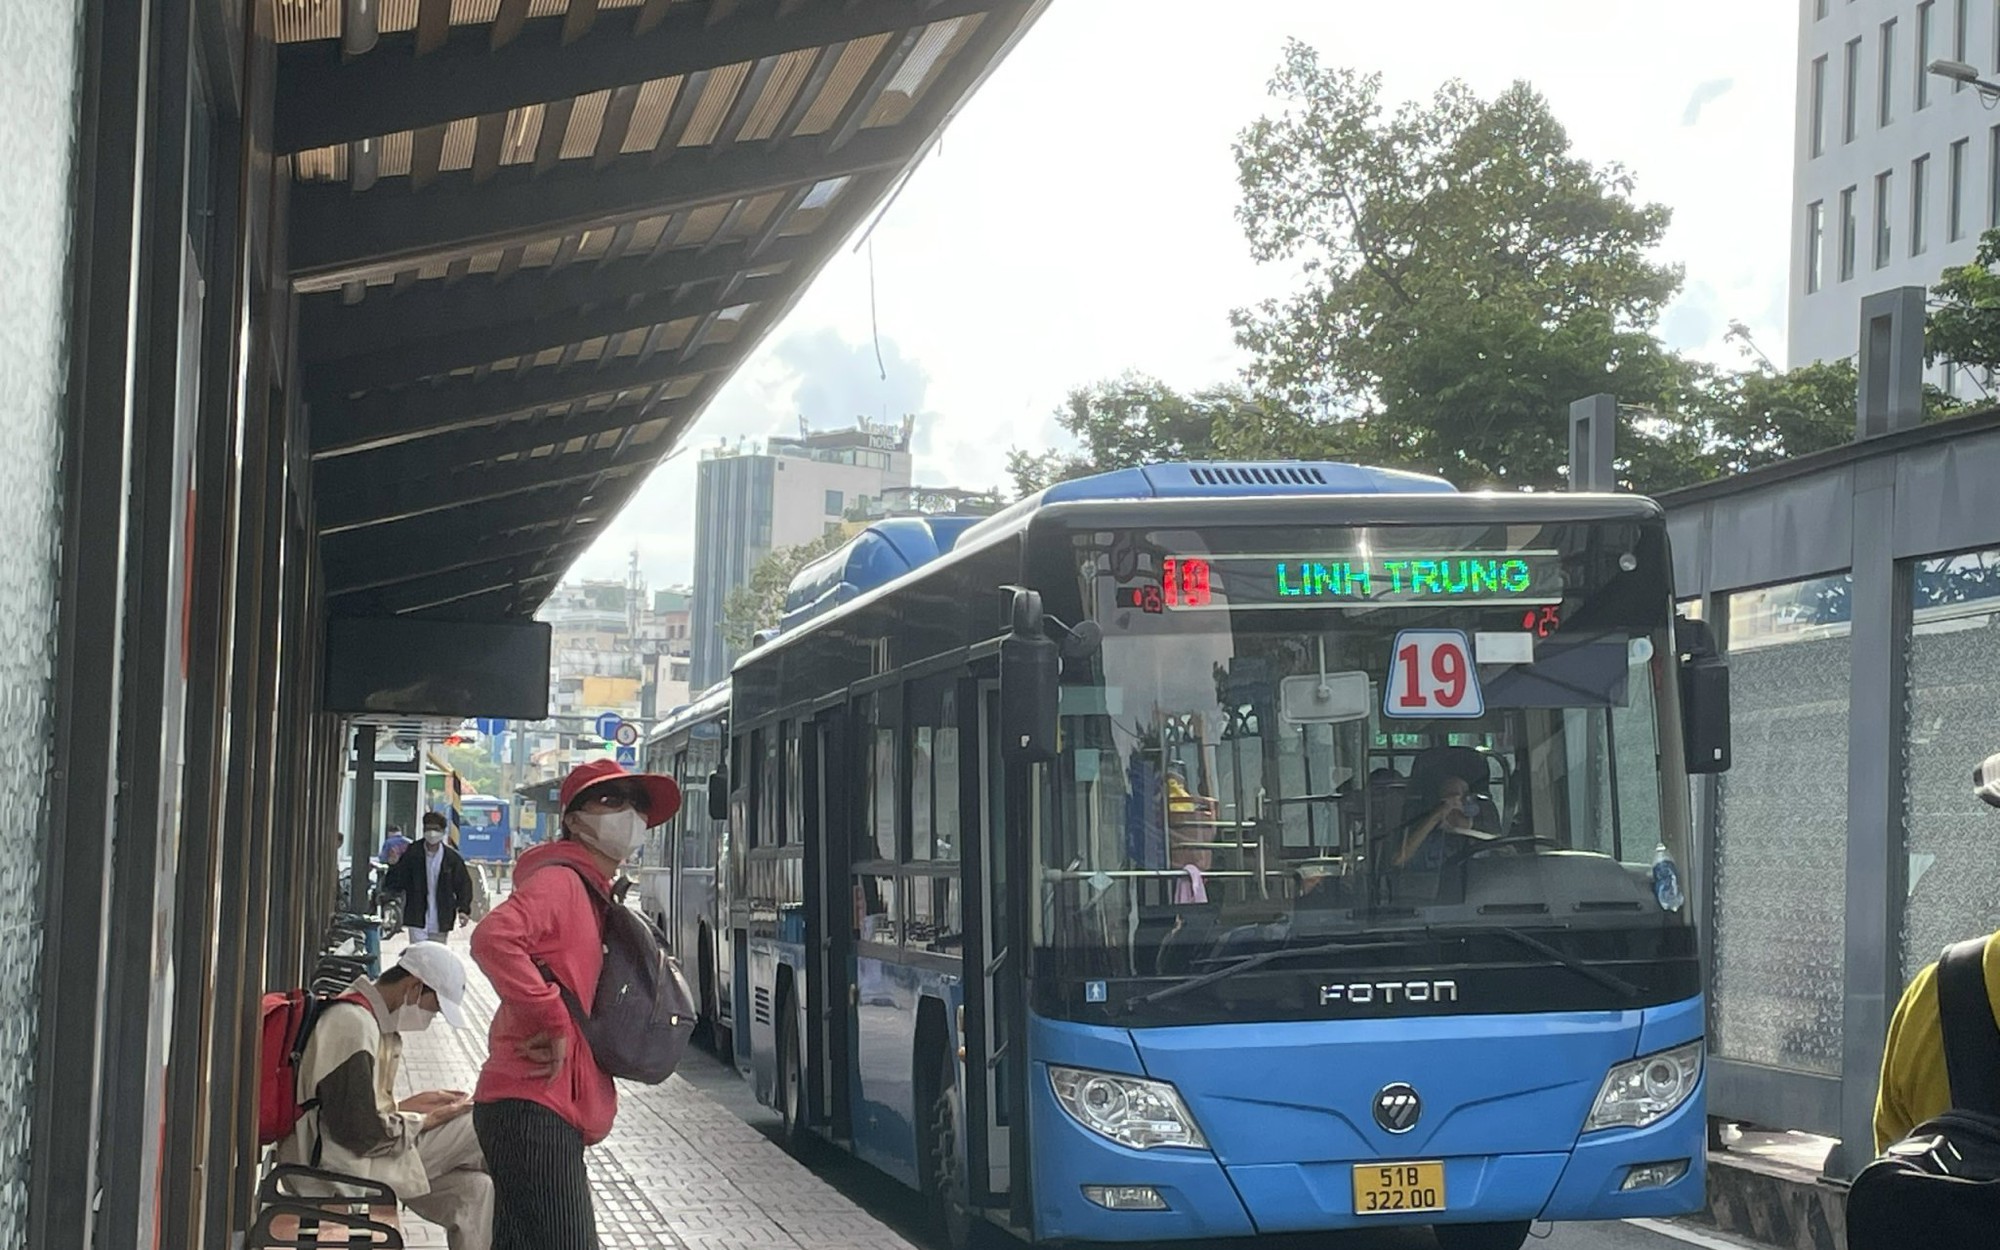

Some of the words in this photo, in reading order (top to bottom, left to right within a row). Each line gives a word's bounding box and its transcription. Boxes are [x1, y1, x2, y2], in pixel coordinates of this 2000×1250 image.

[1163, 557, 1211, 606] 19
[1276, 562, 1371, 595] LINH
[1384, 560, 1530, 593] TRUNG
[1399, 643, 1467, 708] 19
[1320, 981, 1457, 1005] FOTON
[1380, 1167, 1419, 1188] 51B
[1366, 1188, 1436, 1210] 322.00
